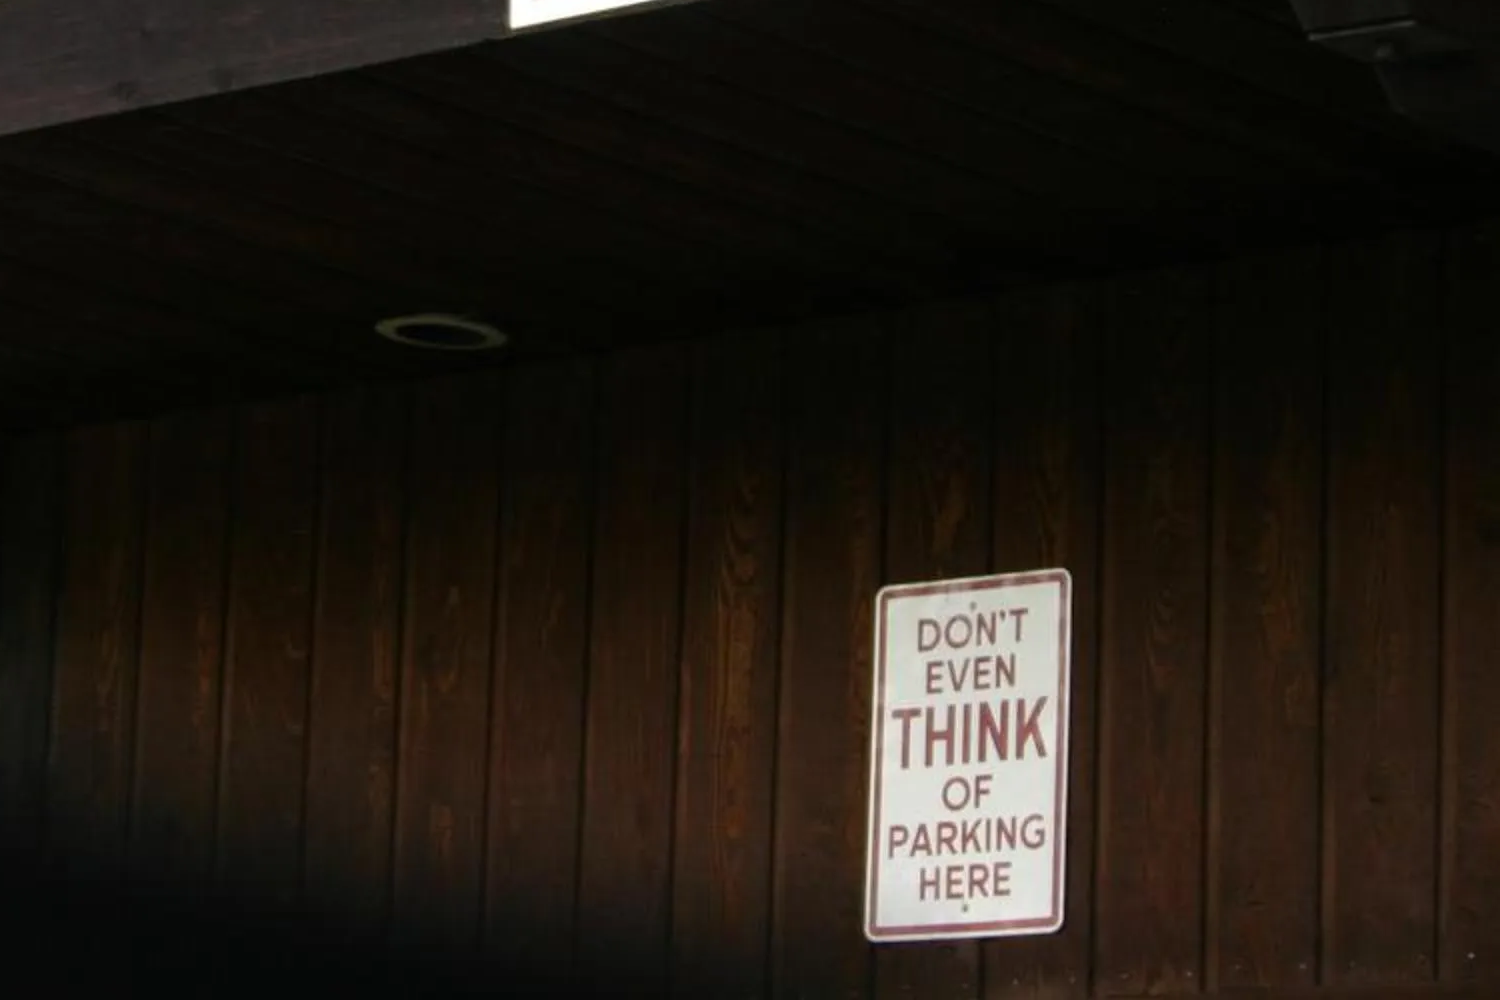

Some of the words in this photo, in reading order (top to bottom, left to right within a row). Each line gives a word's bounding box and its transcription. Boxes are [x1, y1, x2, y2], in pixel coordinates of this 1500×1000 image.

[917, 607, 1029, 653] DON'T
[925, 653, 1016, 694] EVEN
[891, 695, 1049, 769] THINK
[942, 773, 994, 811] OF
[888, 814, 1046, 859] PARKING
[919, 861, 1012, 901] HERE
